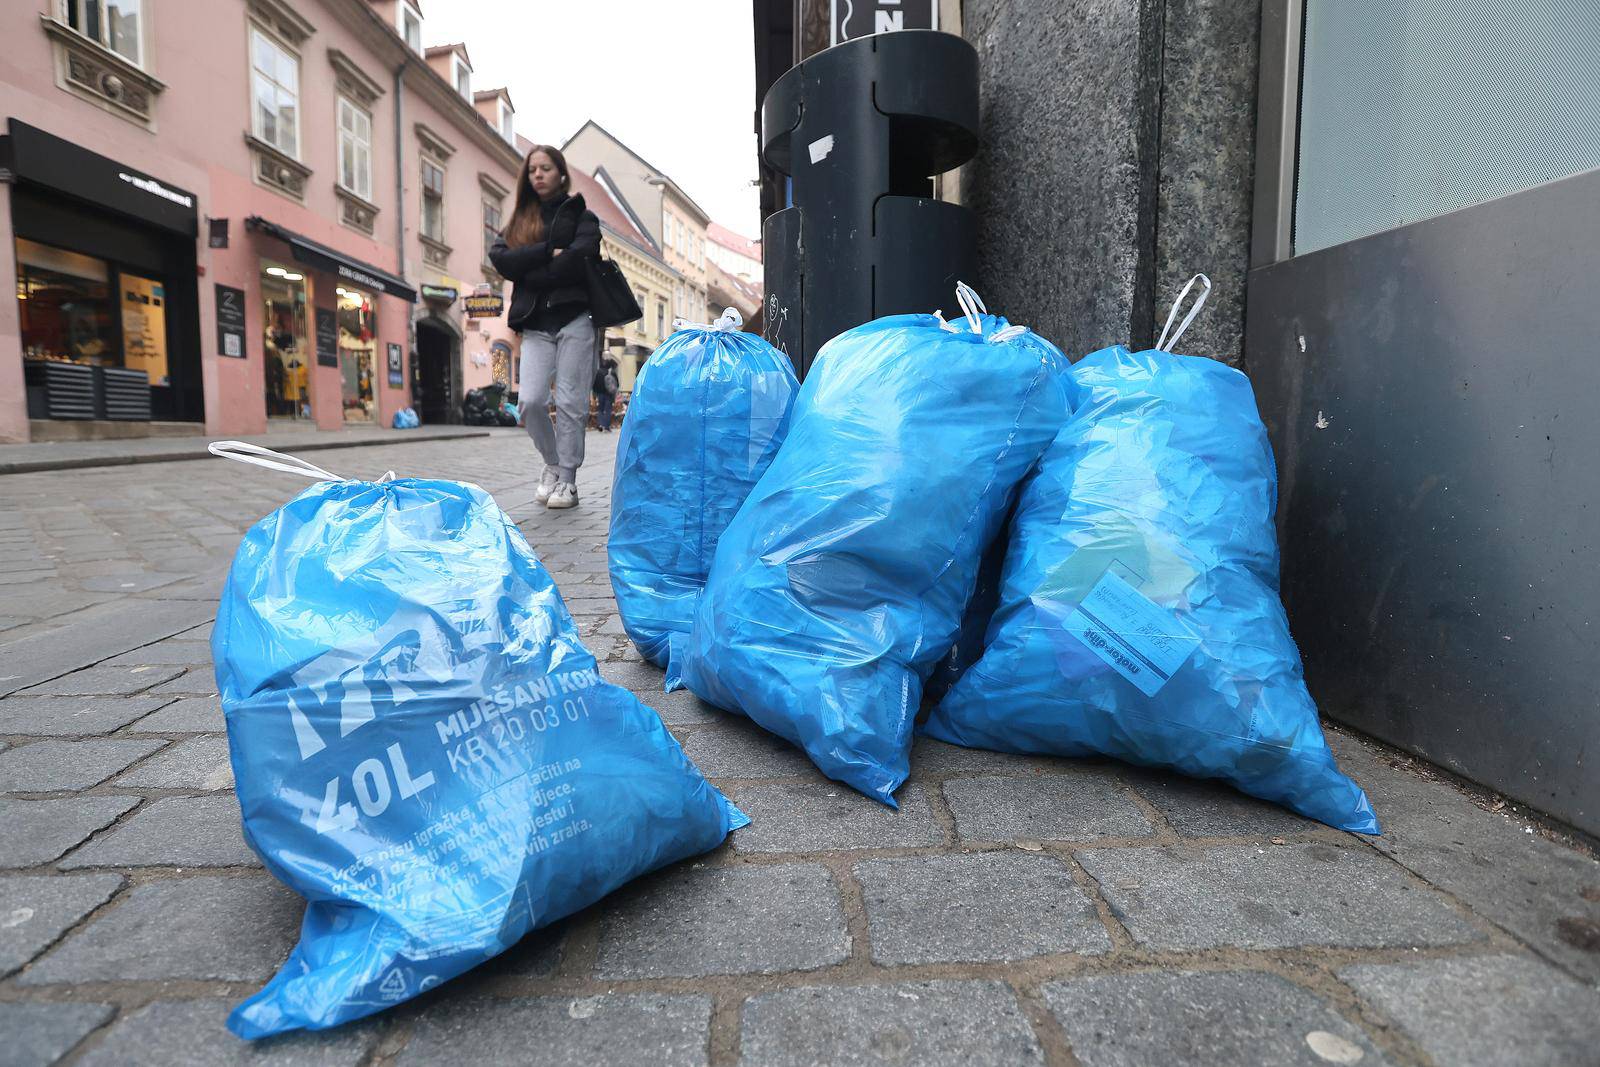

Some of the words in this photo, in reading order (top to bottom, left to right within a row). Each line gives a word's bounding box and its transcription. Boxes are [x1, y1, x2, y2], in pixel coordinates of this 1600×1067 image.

[435, 676, 558, 745] MIJEŠANI
[446, 735, 486, 773] KB
[492, 717, 525, 750] 20
[530, 704, 560, 732] 03
[563, 696, 590, 722] 01
[316, 743, 436, 834] 40L
[378, 840, 415, 861] nisu
[565, 758, 582, 774] na
[516, 805, 567, 835] mjestu
[567, 799, 575, 815] i
[532, 782, 577, 807] djece.
[552, 818, 593, 846] zraka.
